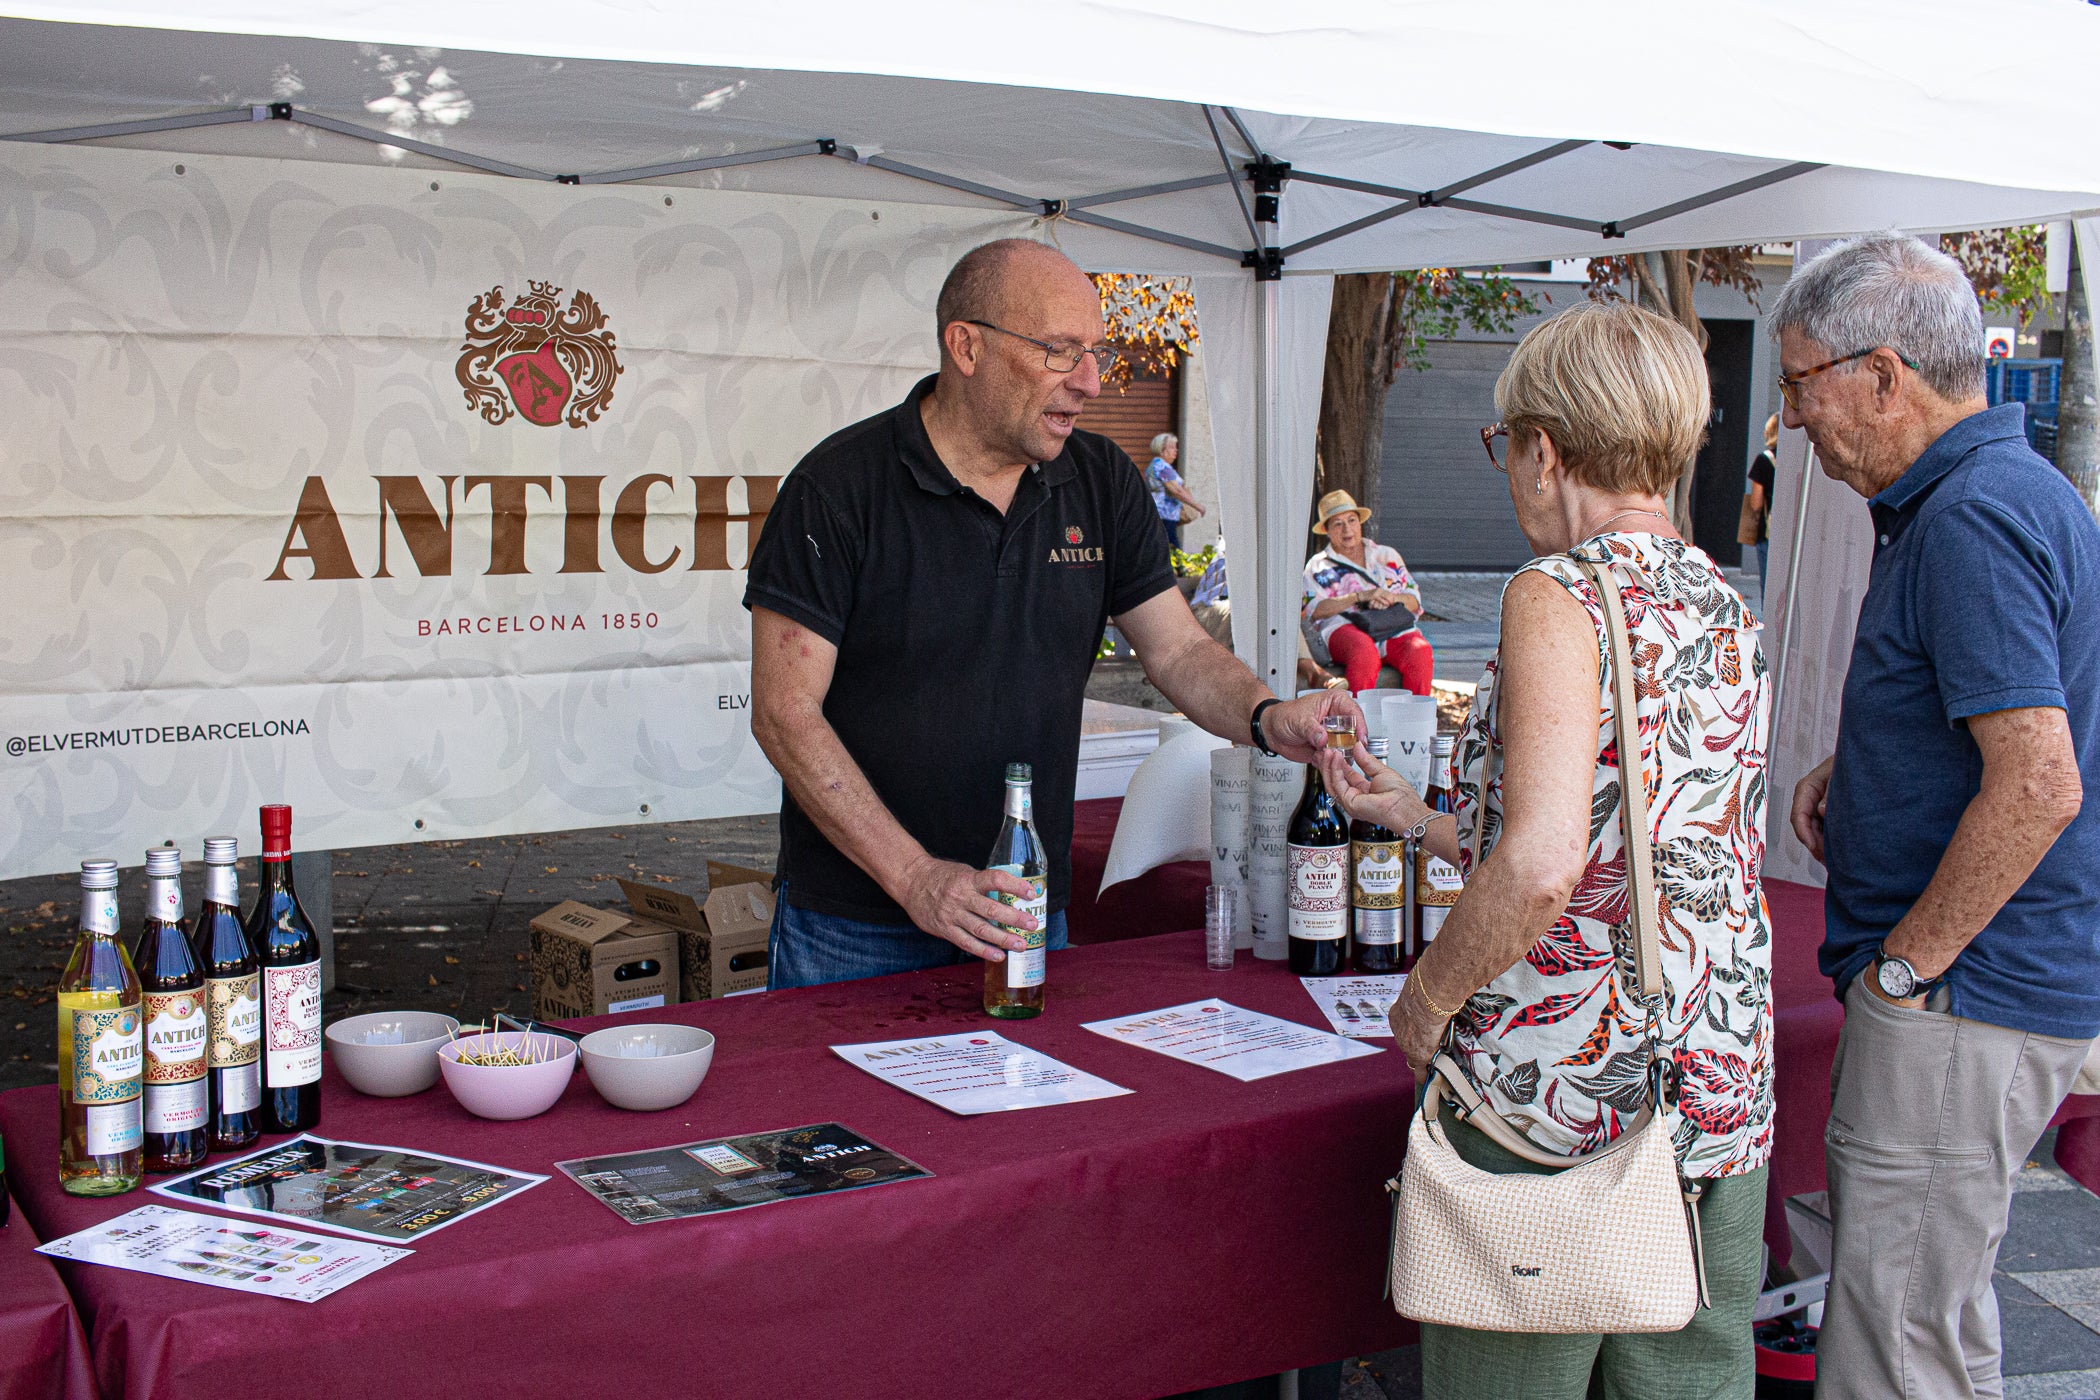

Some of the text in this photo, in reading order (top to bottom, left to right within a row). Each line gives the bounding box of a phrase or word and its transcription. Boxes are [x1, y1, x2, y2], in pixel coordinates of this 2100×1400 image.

[263, 473, 784, 581] ANTICH
[418, 612, 660, 637] BARCELONA 1850
[719, 694, 750, 710] ELV
[6, 718, 311, 758] @ELVERMUTDEBARCELONA
[1304, 872, 1337, 881] ANTICH
[1359, 868, 1402, 881] ANTICH
[151, 1024, 205, 1044] ANTICH
[97, 1042, 142, 1063] ANTIC
[803, 1144, 873, 1163] ANTICH
[200, 1151, 313, 1188] REMEIER
